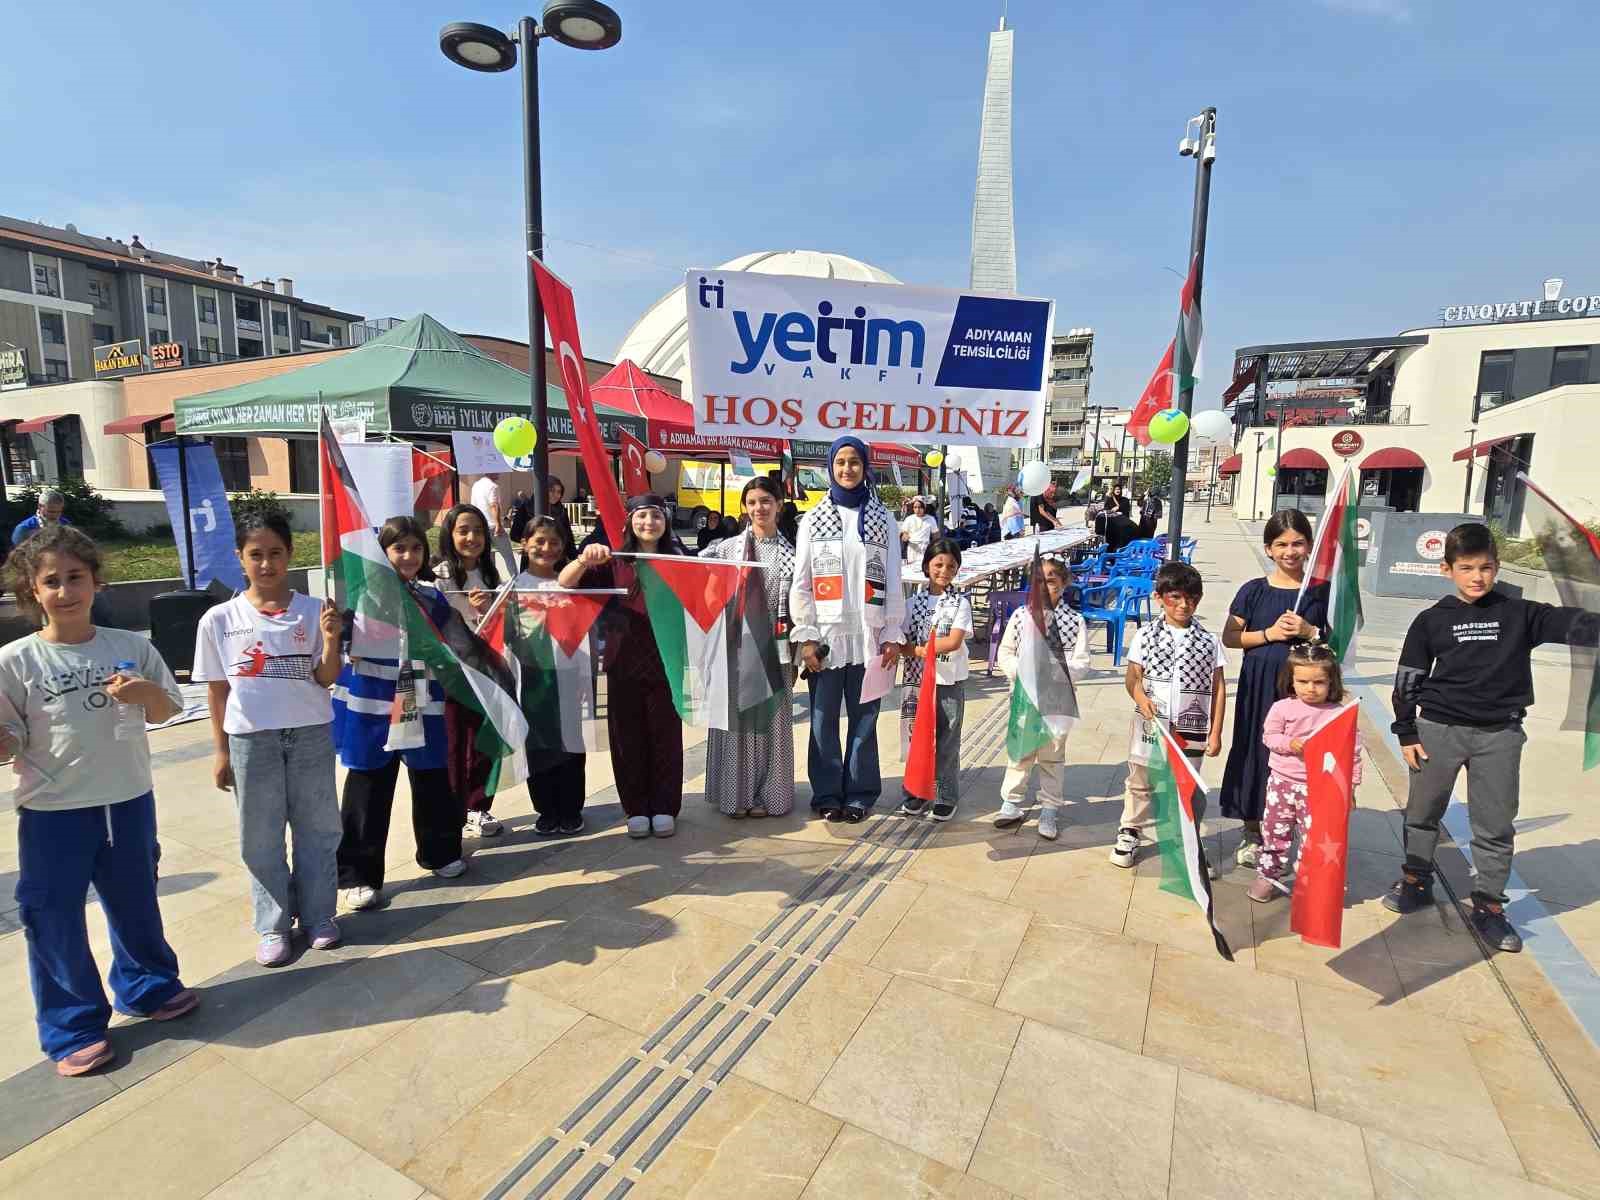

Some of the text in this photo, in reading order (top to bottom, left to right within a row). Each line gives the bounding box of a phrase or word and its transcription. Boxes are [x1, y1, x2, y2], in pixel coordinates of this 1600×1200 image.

[1445, 301, 1541, 321] CINOVATI
[731, 301, 925, 374] yetim
[965, 328, 1032, 344] ADIYAMAN
[152, 344, 180, 360] ESTO
[952, 344, 1031, 361] TEMSİLCİLİĞİ
[95, 359, 117, 372] HAKAN
[253, 404, 285, 423] ZAMAN
[287, 404, 304, 422] HER
[460, 408, 494, 428] İYİLİK
[703, 395, 1031, 438] HOŞ GELDİNİZ
[670, 432, 706, 446] ADIYAMAN
